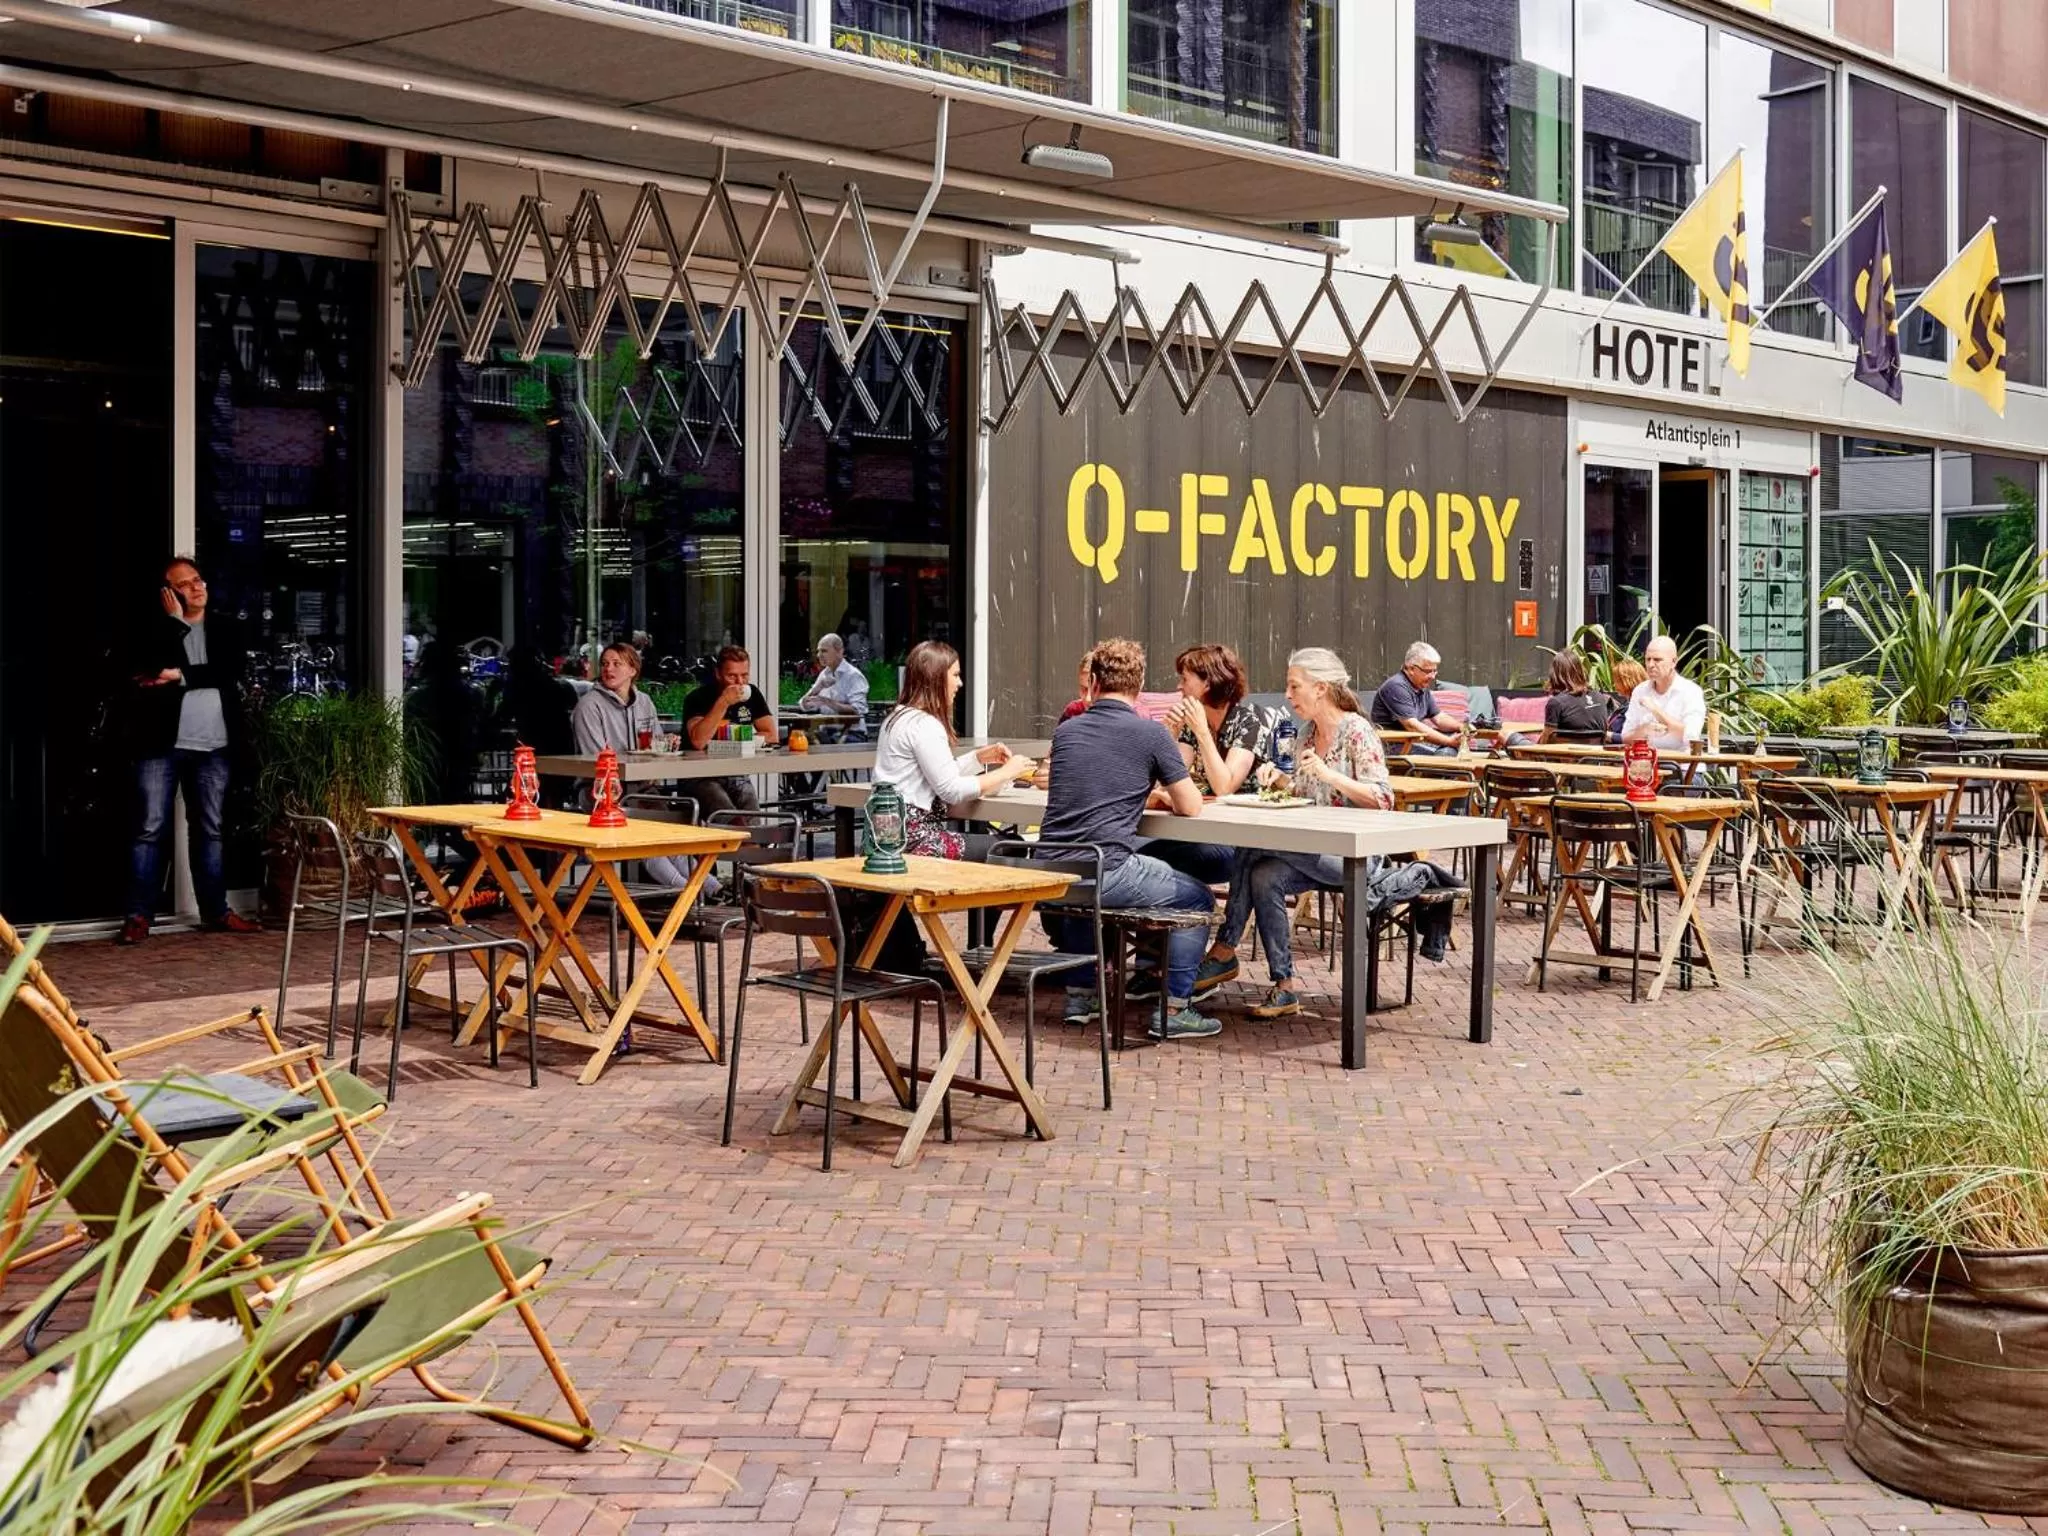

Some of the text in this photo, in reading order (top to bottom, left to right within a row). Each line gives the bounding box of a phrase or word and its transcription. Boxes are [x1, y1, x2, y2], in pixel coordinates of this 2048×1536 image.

[1592, 322, 1721, 397] HOTEL
[1645, 419, 1741, 450] Atlantisplein 1
[1067, 464, 1520, 582] Q-FACTORY
